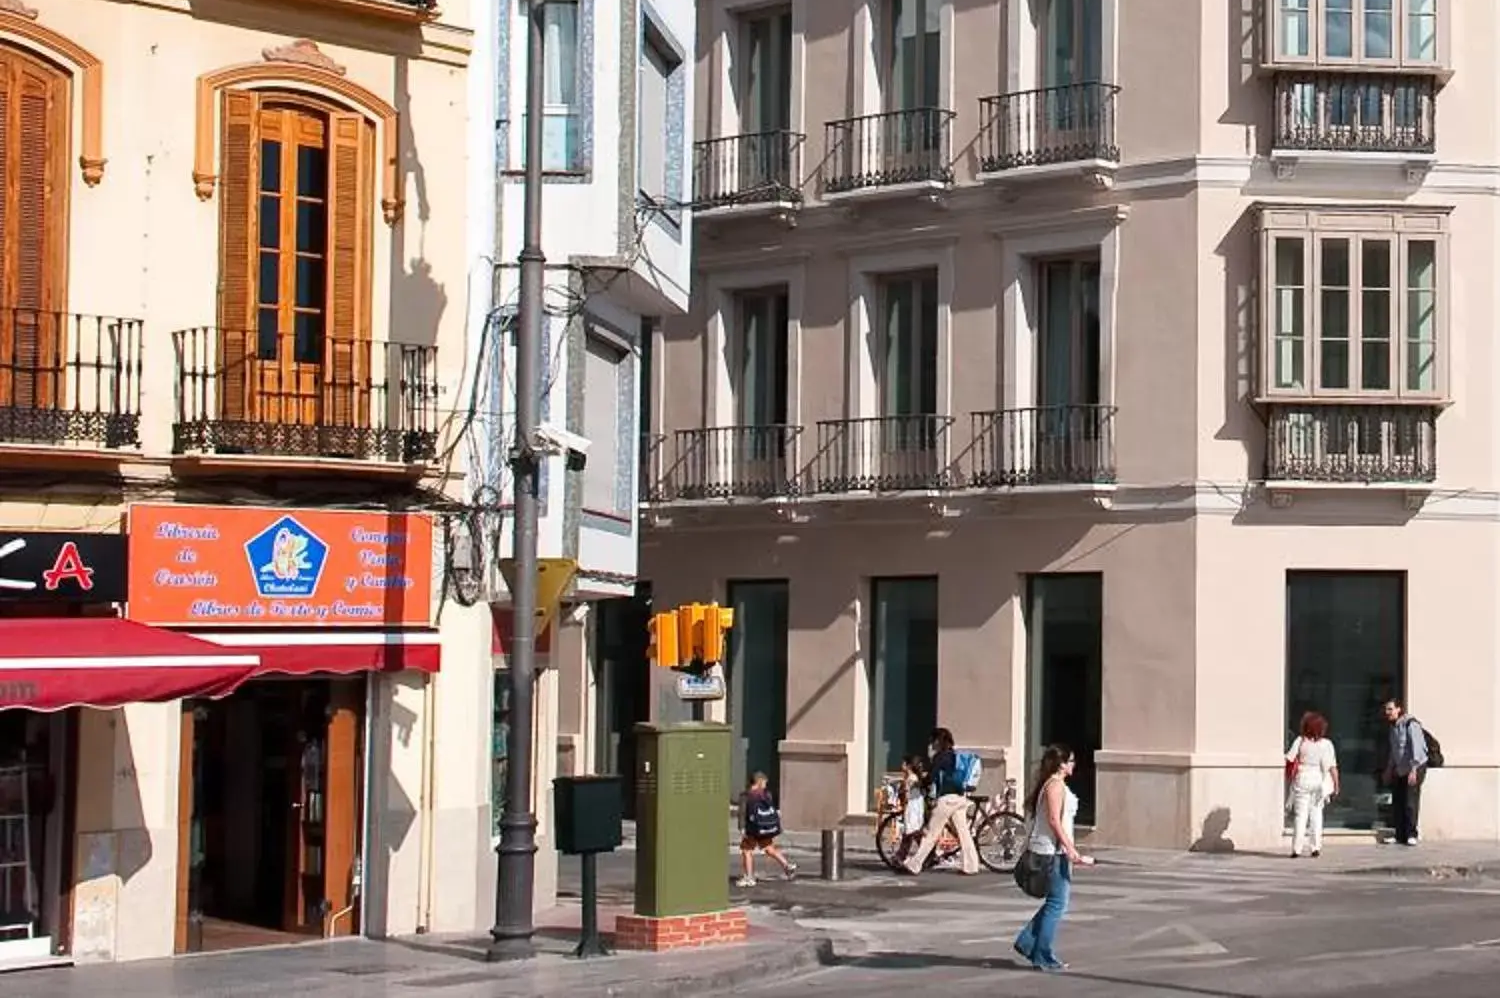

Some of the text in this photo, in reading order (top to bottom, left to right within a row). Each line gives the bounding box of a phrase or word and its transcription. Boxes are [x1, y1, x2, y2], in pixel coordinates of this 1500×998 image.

[176, 547, 196, 563] de
[345, 577, 357, 592] y
[190, 599, 240, 617] Libros
[246, 601, 264, 617] de
